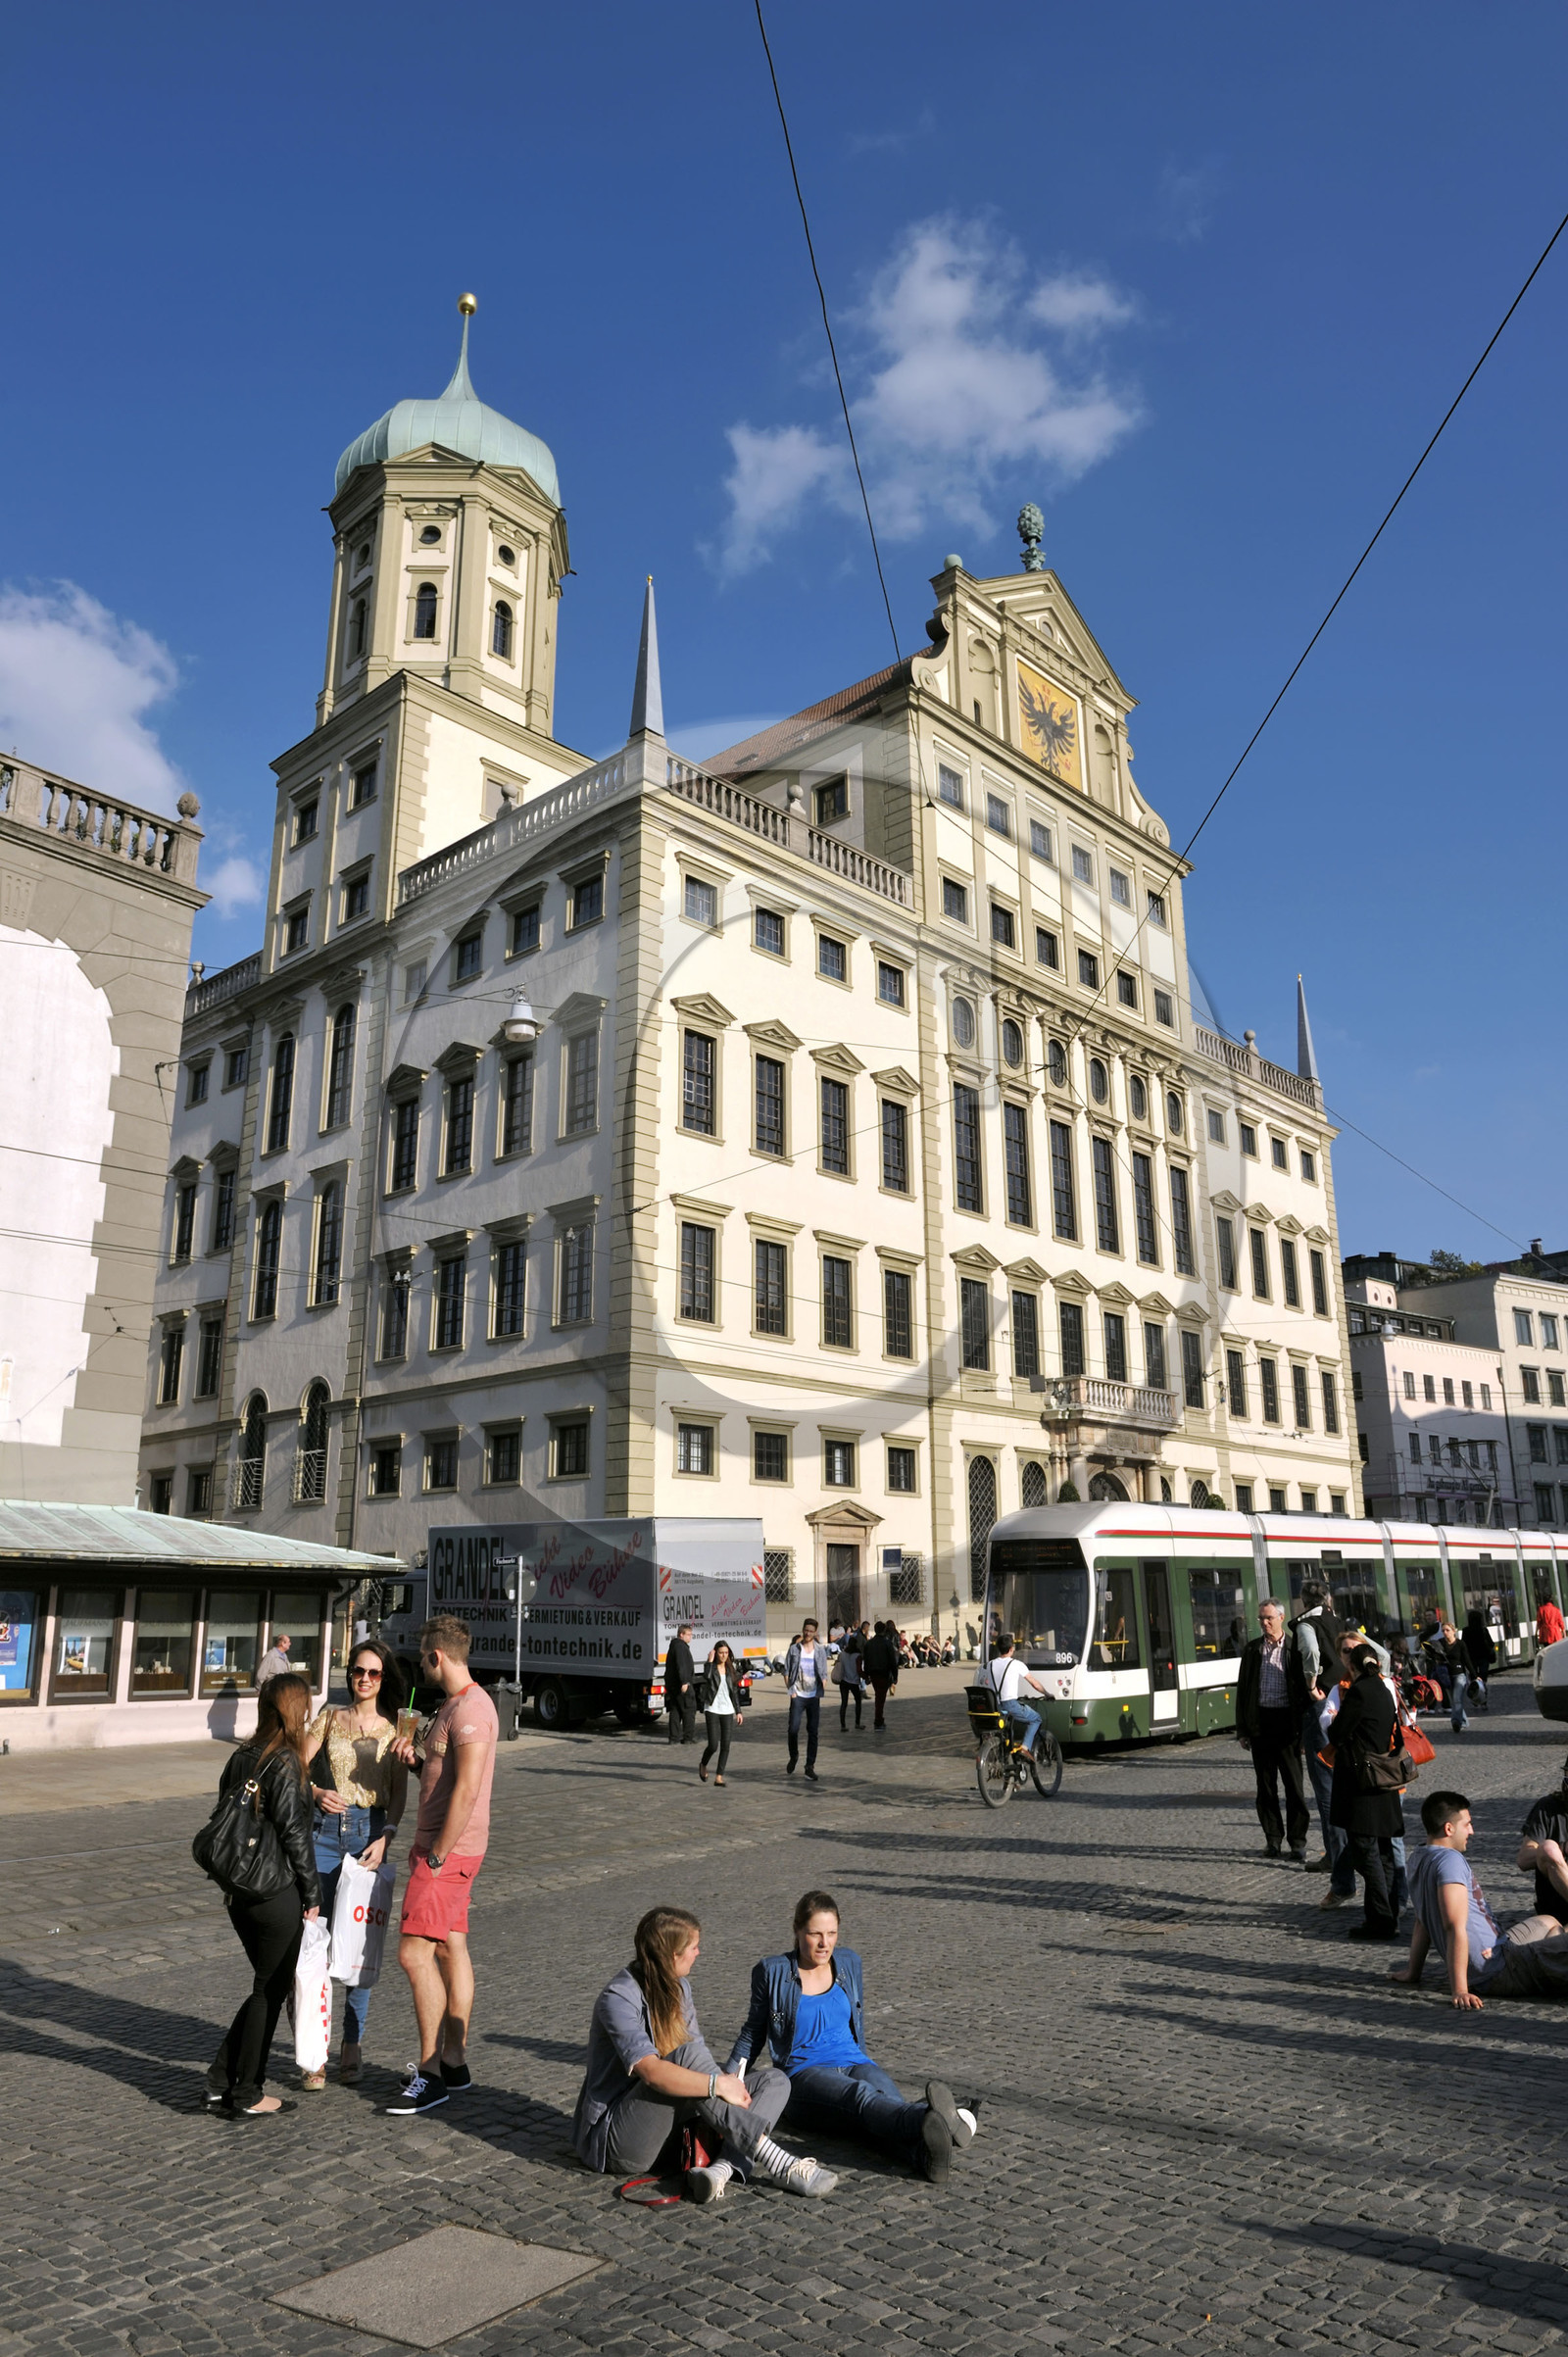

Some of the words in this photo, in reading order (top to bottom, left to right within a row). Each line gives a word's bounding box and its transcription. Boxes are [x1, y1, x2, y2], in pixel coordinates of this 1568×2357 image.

[433, 1537, 509, 1600] GRANDEL
[549, 1546, 594, 1599] Video
[588, 1531, 642, 1599] Bühne
[523, 1608, 584, 1625] ERMIETUNG
[593, 1610, 641, 1627] VERKAUF
[662, 1595, 704, 1622] GRANDEL
[468, 1635, 642, 1660] grande-tontechnik.de
[1055, 1651, 1073, 1664] 896
